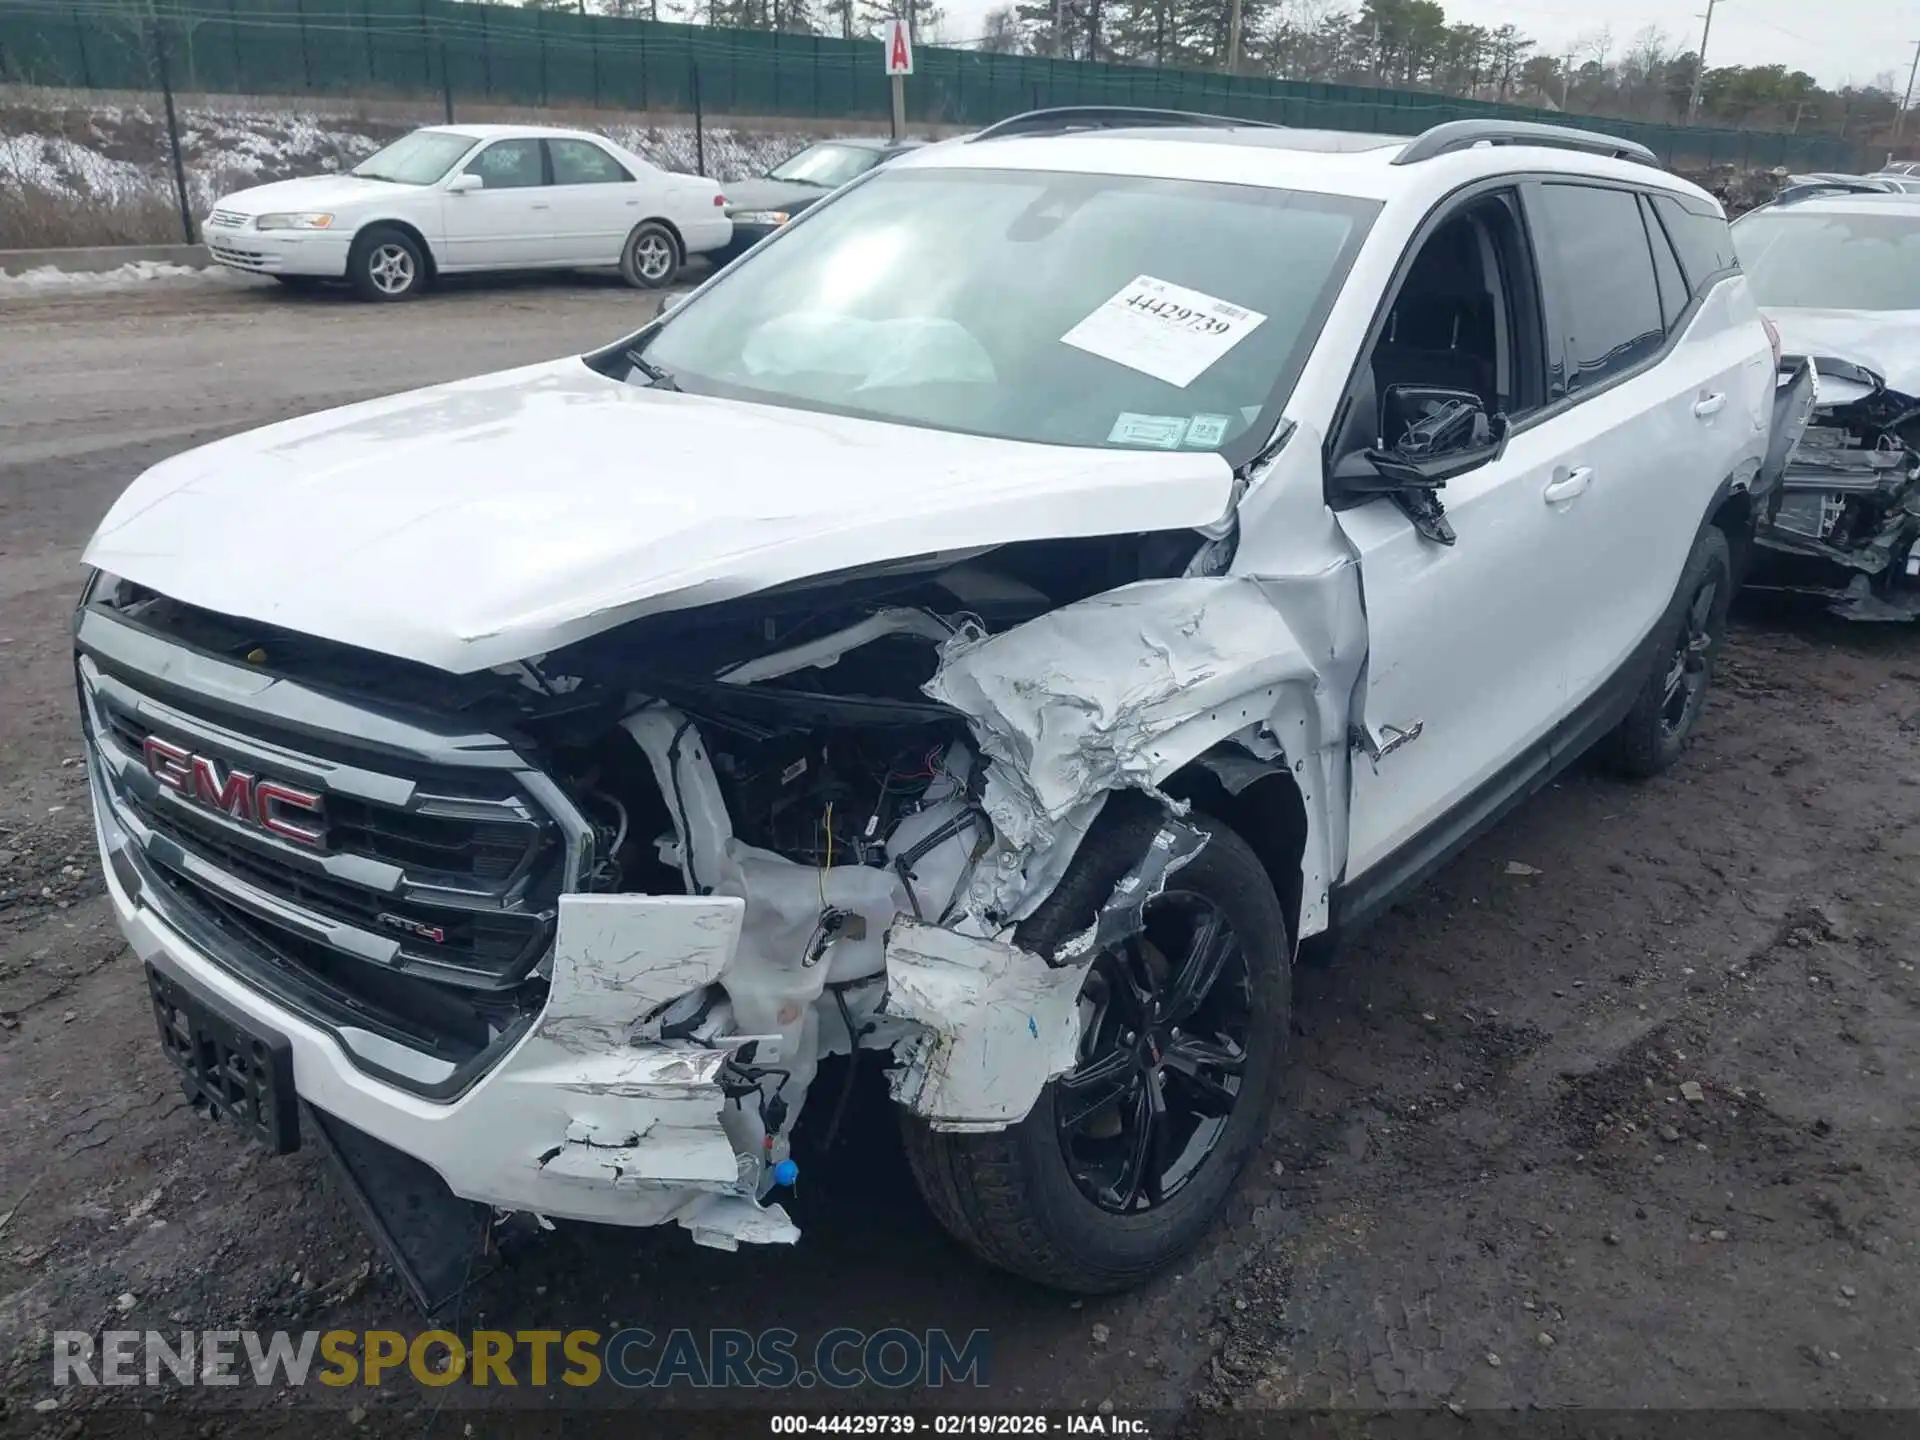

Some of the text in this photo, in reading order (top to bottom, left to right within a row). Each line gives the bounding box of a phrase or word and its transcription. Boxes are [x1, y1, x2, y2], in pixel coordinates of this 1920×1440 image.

[892, 23, 908, 69] A
[1125, 294, 1230, 335] 44429739
[144, 735, 327, 850] GMC
